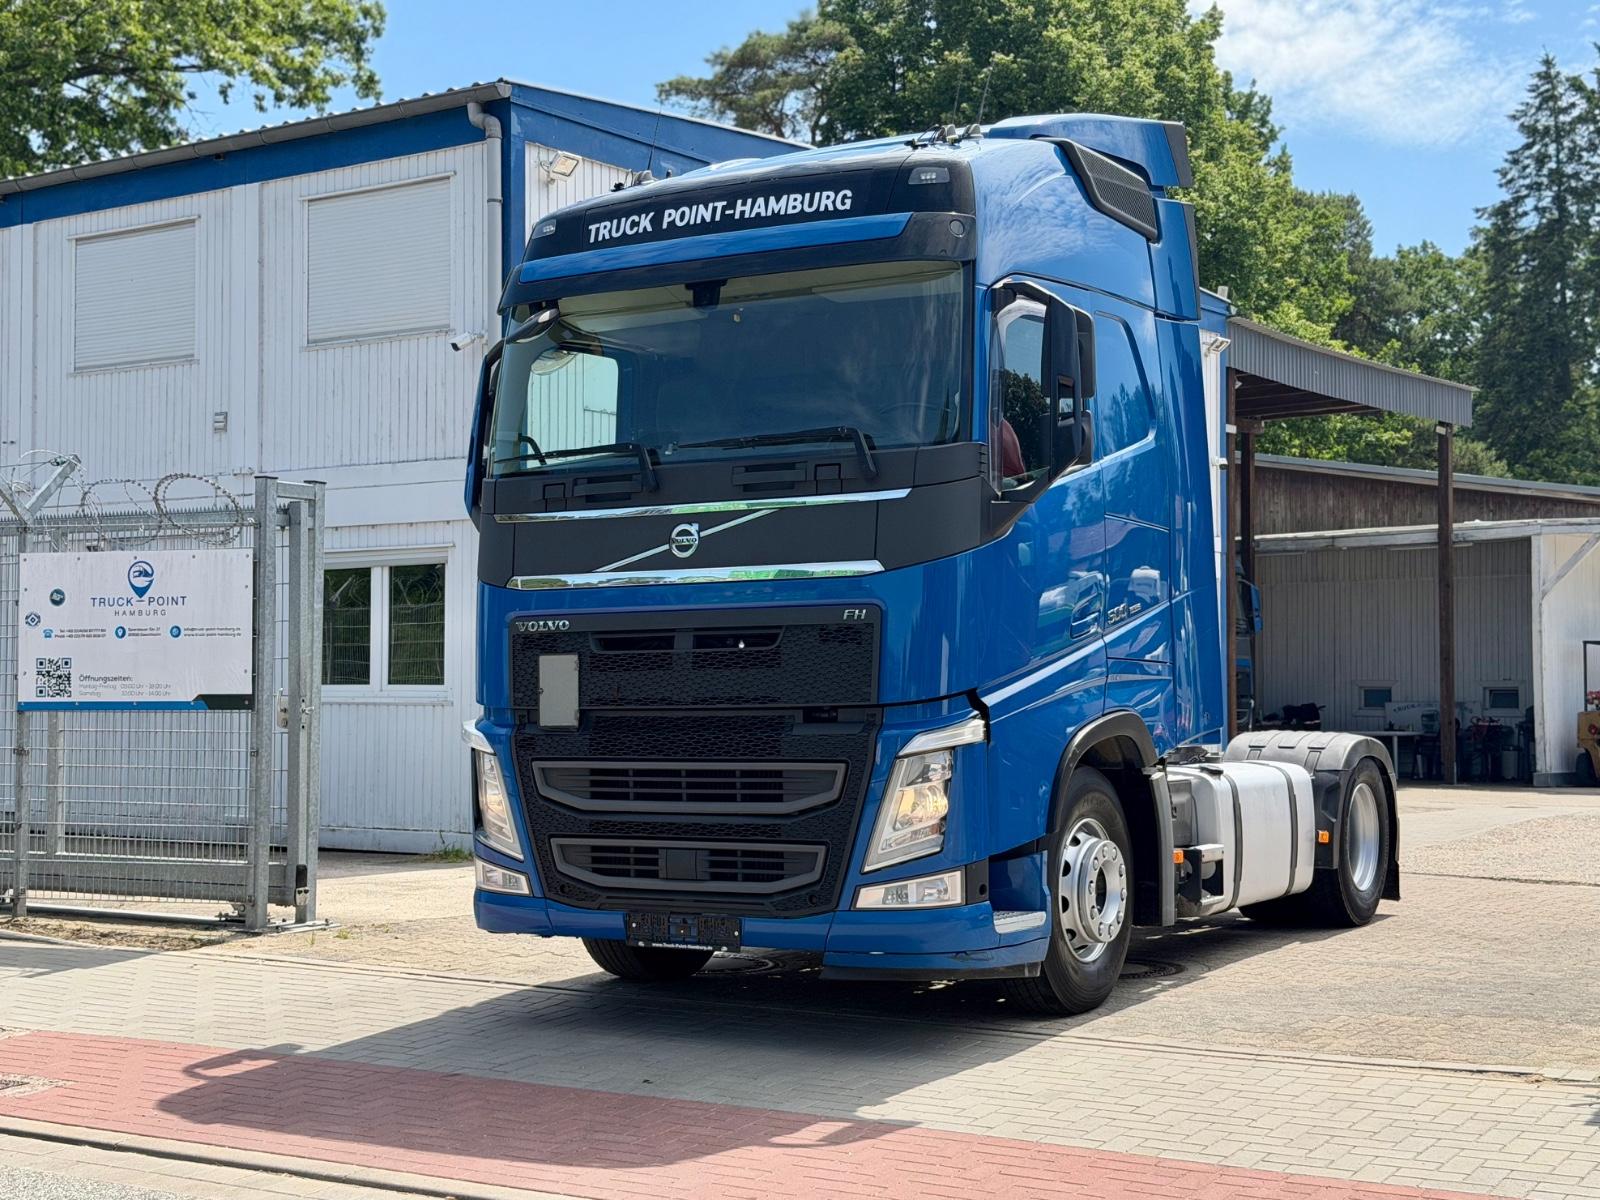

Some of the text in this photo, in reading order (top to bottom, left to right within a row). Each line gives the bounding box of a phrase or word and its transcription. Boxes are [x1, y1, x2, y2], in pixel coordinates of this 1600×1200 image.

[588, 188, 853, 244] TRUCK POINT-HAMBURG
[671, 537, 698, 545] VOLVO
[91, 596, 187, 607] TRUCK POINT
[843, 608, 867, 621] FH
[515, 619, 570, 632] VOLVO
[79, 674, 133, 684] Öffnungszeiten:
